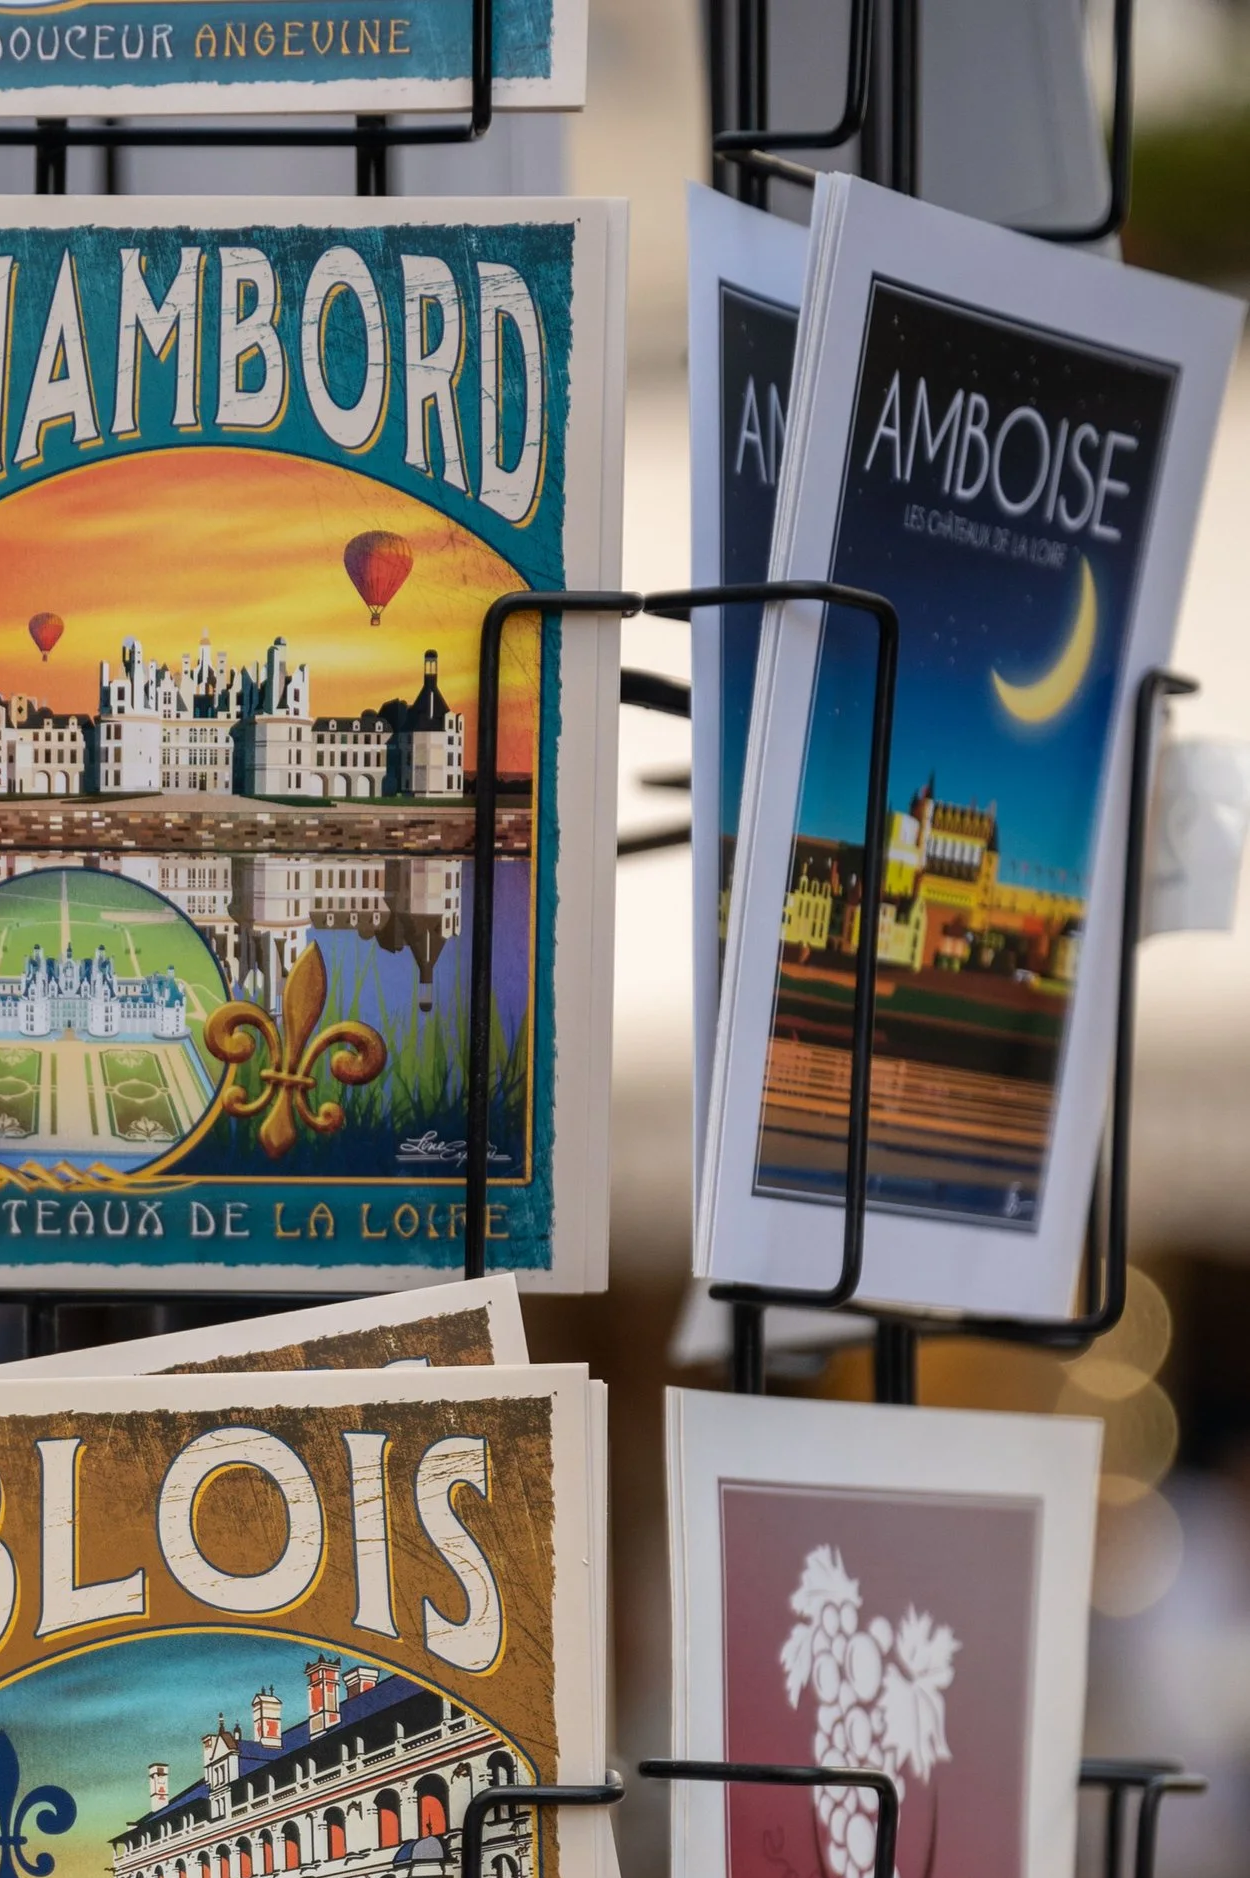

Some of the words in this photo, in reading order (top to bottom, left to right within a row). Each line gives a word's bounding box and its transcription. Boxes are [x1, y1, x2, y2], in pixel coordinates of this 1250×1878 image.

[864, 368, 1140, 542] AMBOISE
[190, 1201, 250, 1238] DE
[274, 1203, 336, 1239] LA
[361, 1203, 510, 1239] LOIRE
